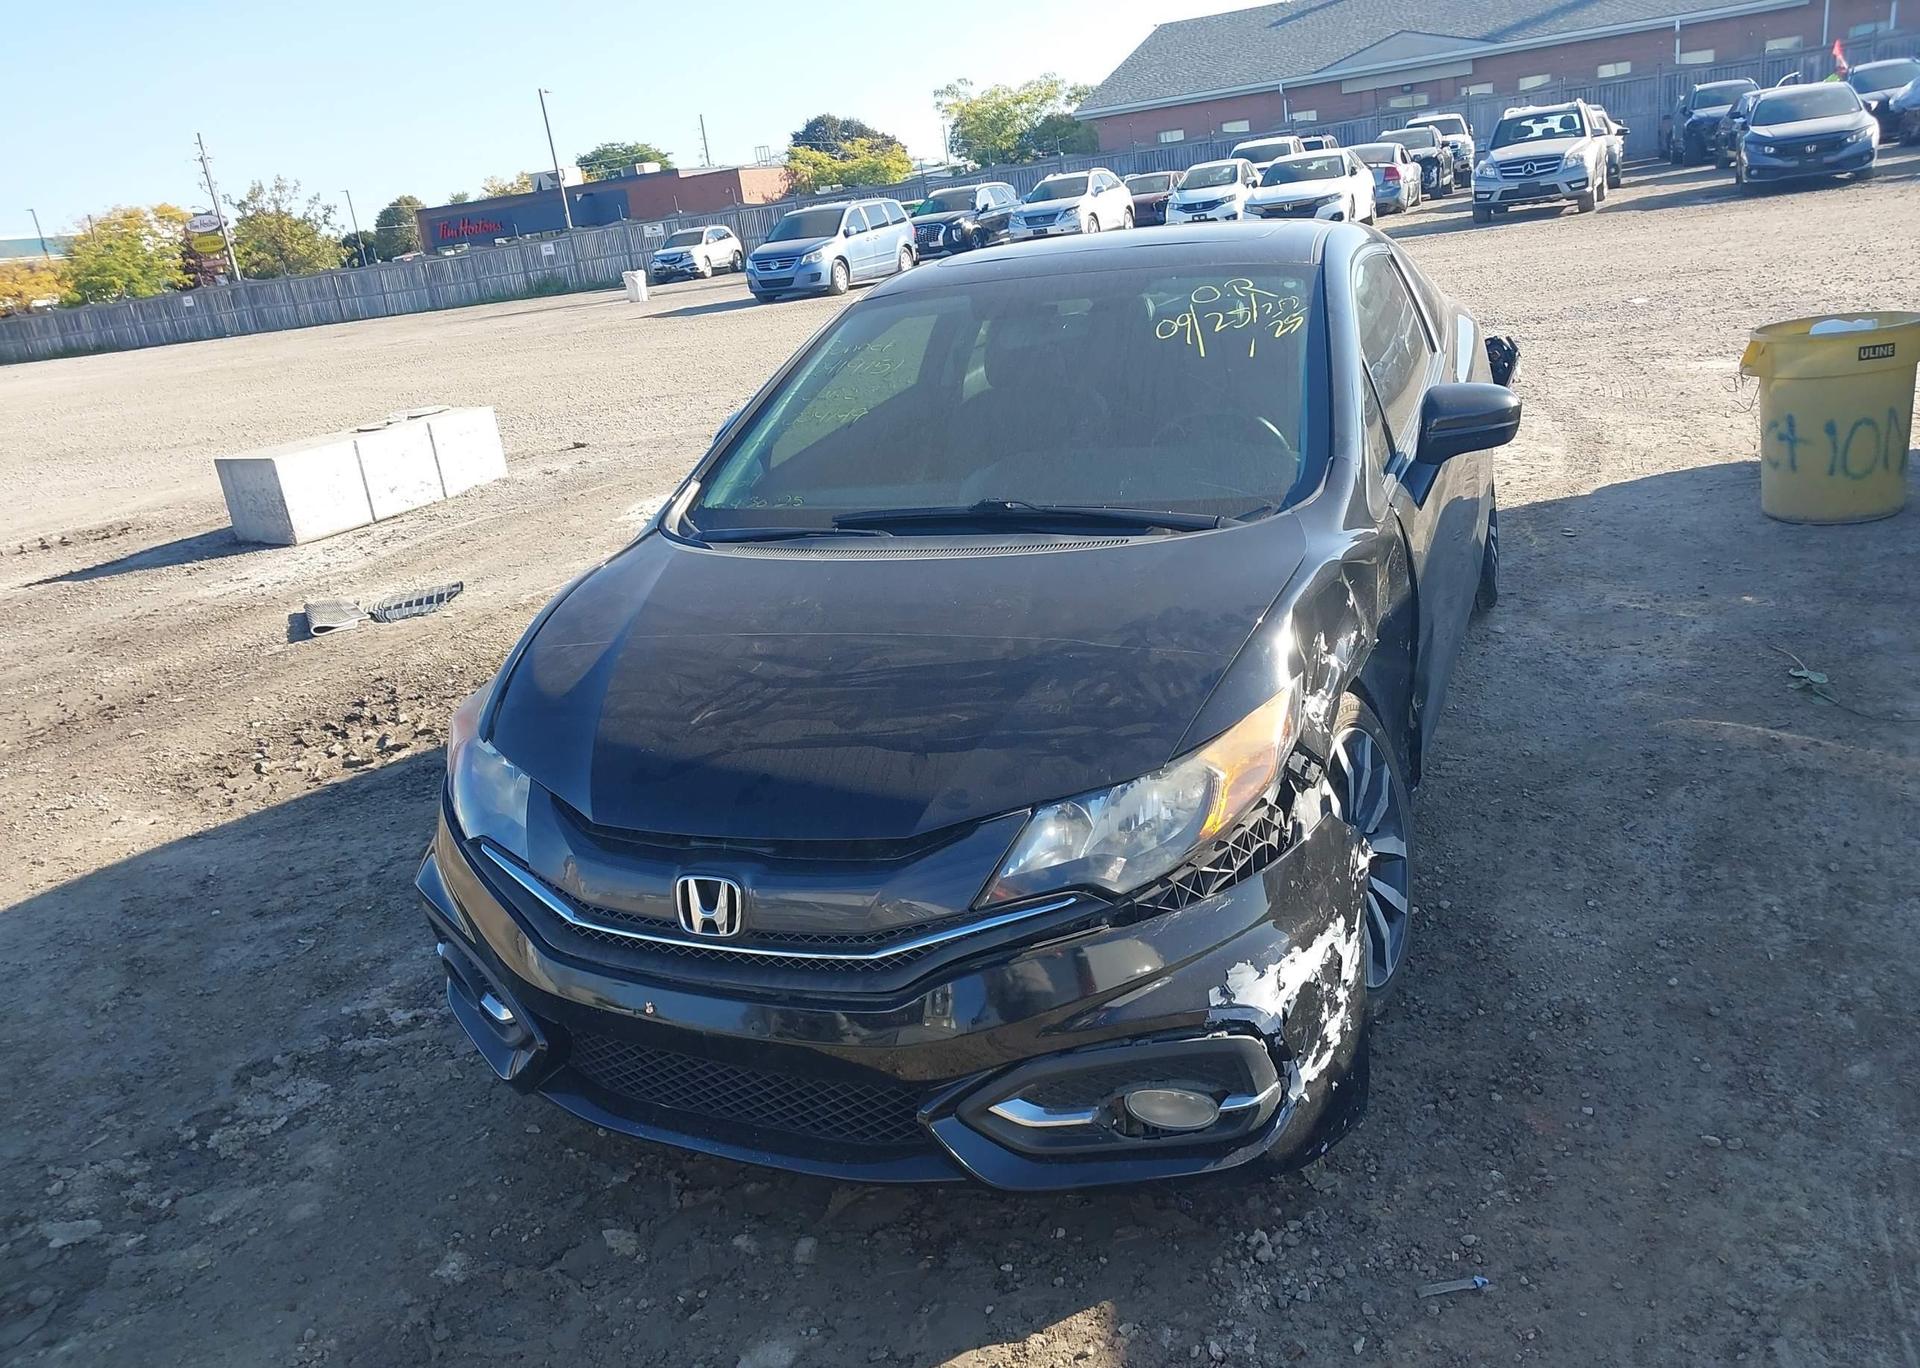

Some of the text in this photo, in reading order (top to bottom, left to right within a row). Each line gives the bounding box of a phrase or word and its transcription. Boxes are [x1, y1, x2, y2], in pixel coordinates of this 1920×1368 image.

[437, 217, 505, 239] Tim Hortons
[1860, 344, 1894, 359] ULINE
